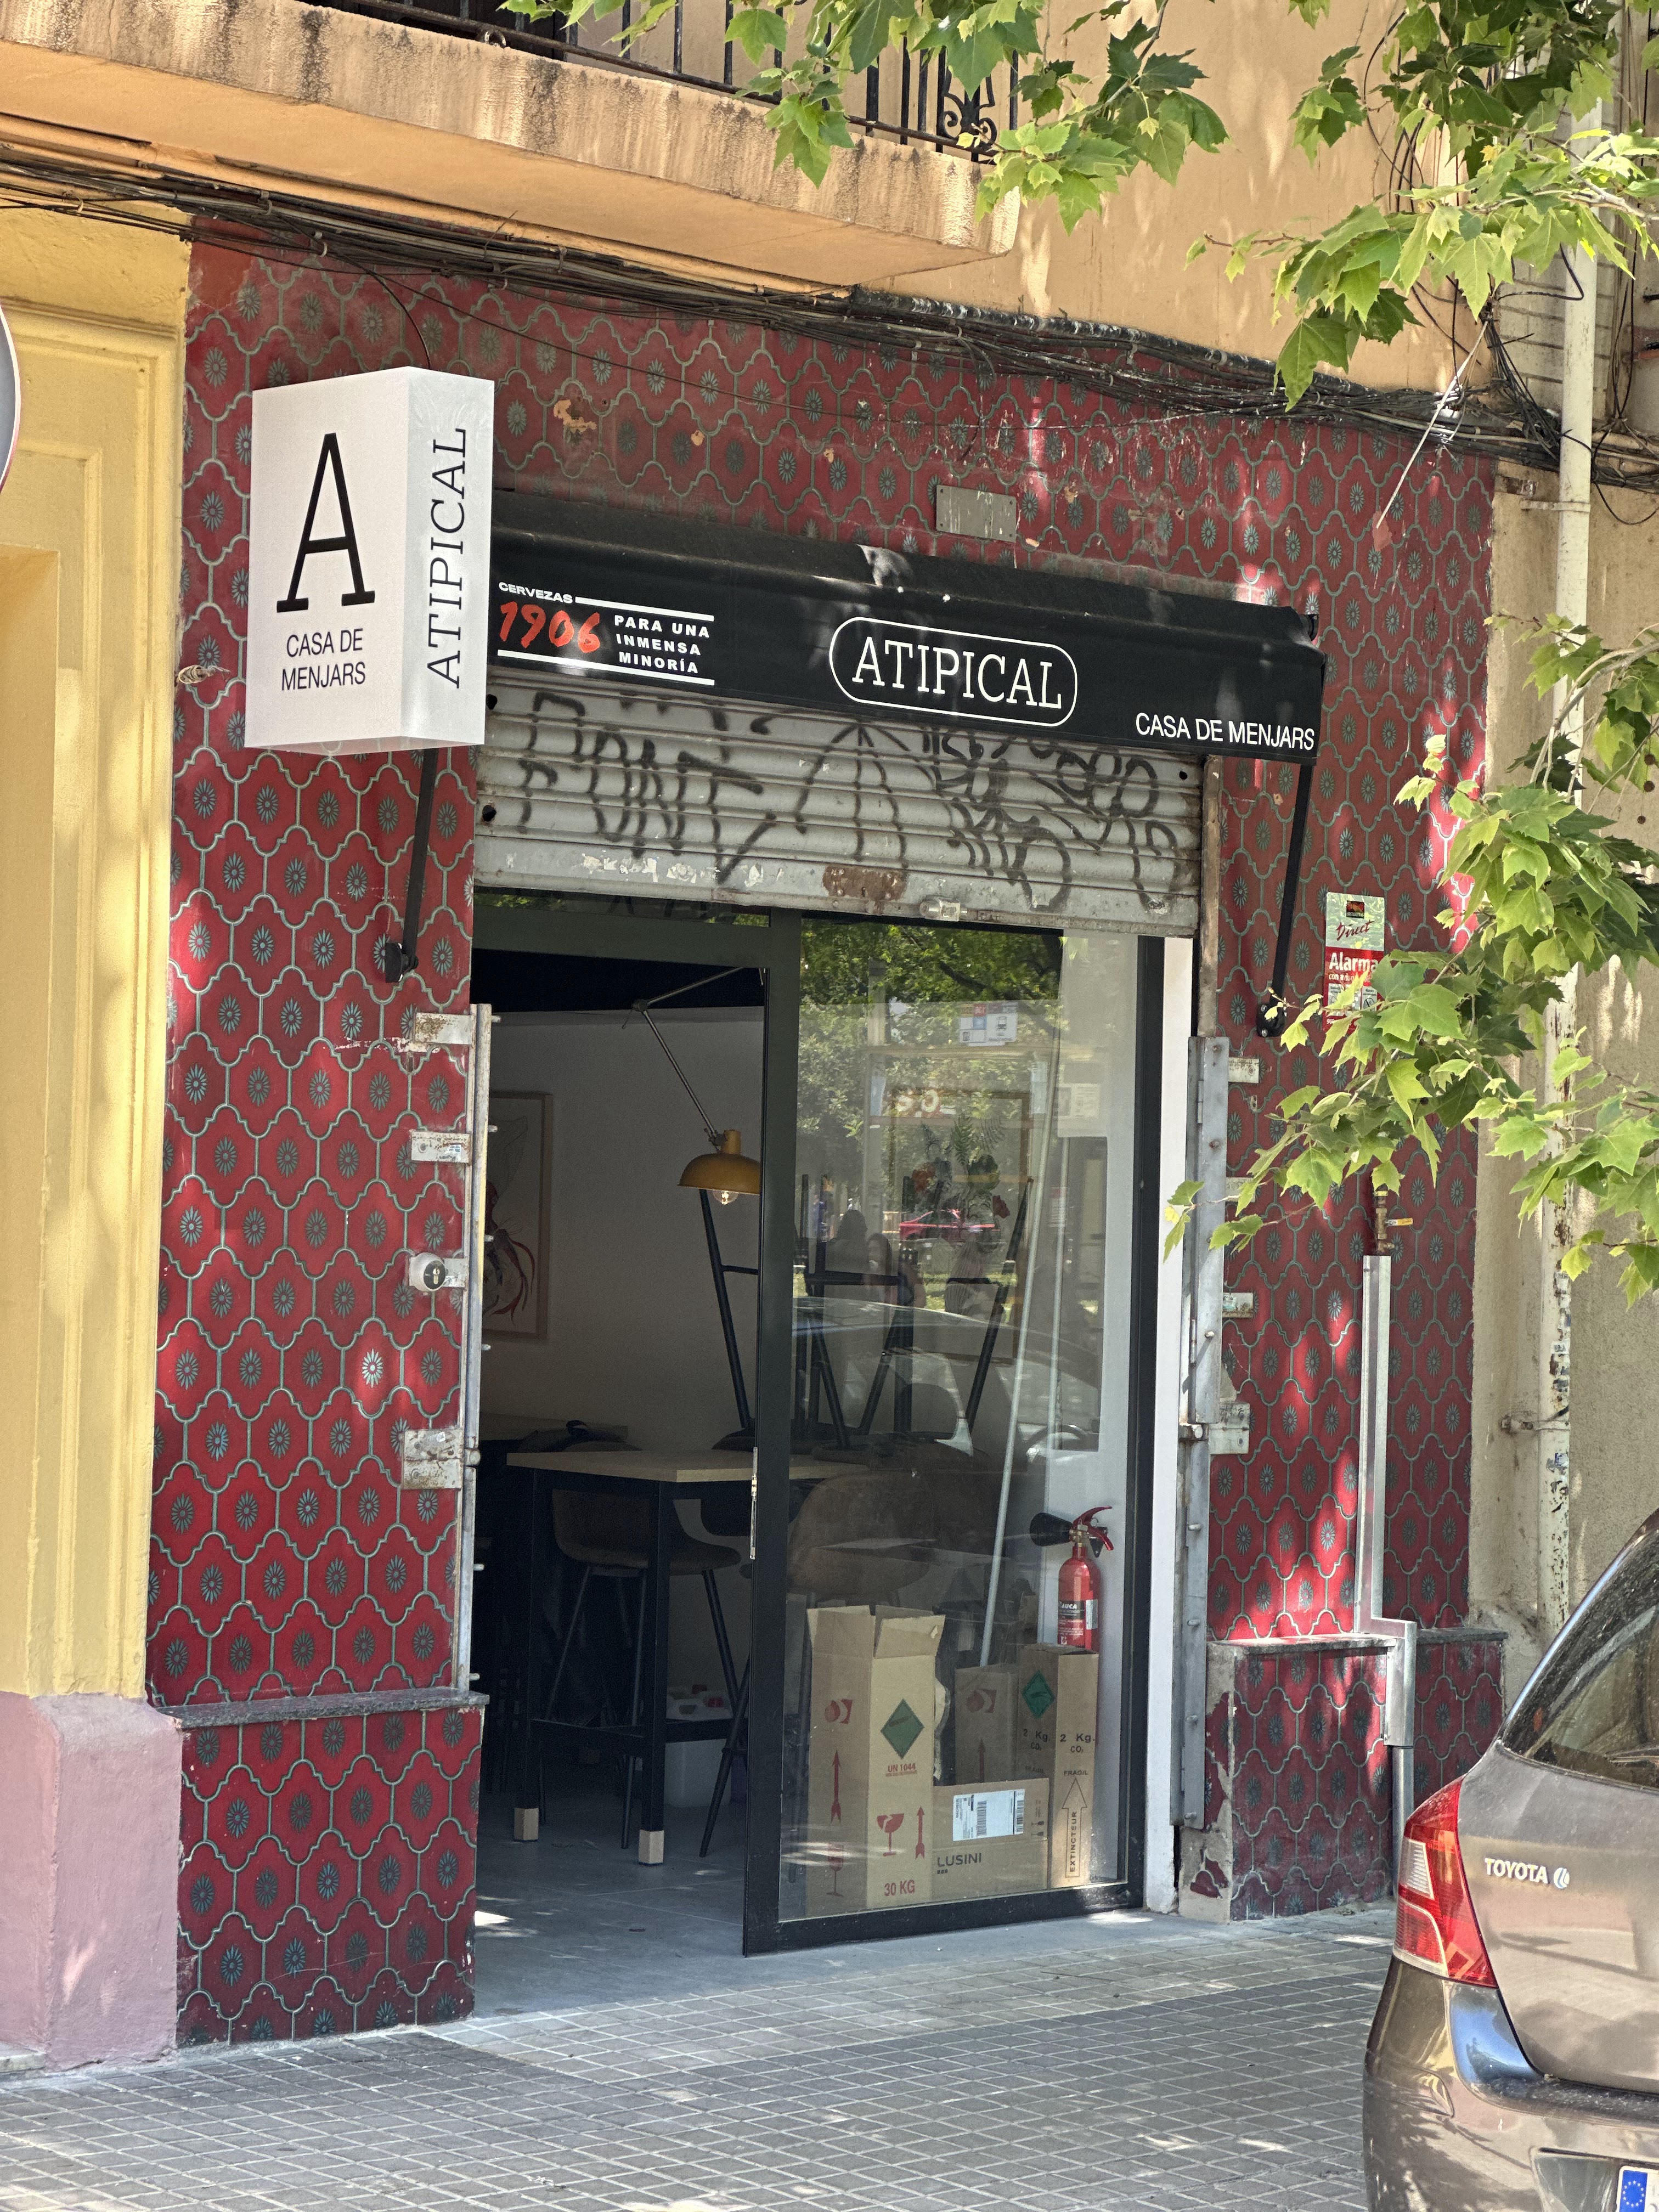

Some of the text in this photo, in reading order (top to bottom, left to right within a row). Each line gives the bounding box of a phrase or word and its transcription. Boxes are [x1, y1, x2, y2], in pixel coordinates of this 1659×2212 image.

[276, 432, 375, 613] A
[427, 428, 466, 689] ATIPICAL
[498, 582, 573, 604] CERVEZAS
[499, 601, 601, 653] 1906
[614, 614, 710, 638] PARA UNA
[286, 628, 363, 657] CASA DE
[616, 633, 701, 656] INMENSA
[619, 651, 698, 674] MINORÍA
[851, 636, 1062, 709] ATIPICAL
[281, 661, 365, 691] MENJARS
[1136, 712, 1315, 751] CASA DE MENJARS
[1336, 919, 1374, 941] Direct
[1059, 1734, 1066, 1742] 2
[888, 1763, 916, 1773] UN 1044
[937, 1852, 982, 1867] LUSINI
[1484, 1858, 1549, 1884] TOYOTA
[884, 1879, 916, 1897] 30 KG
